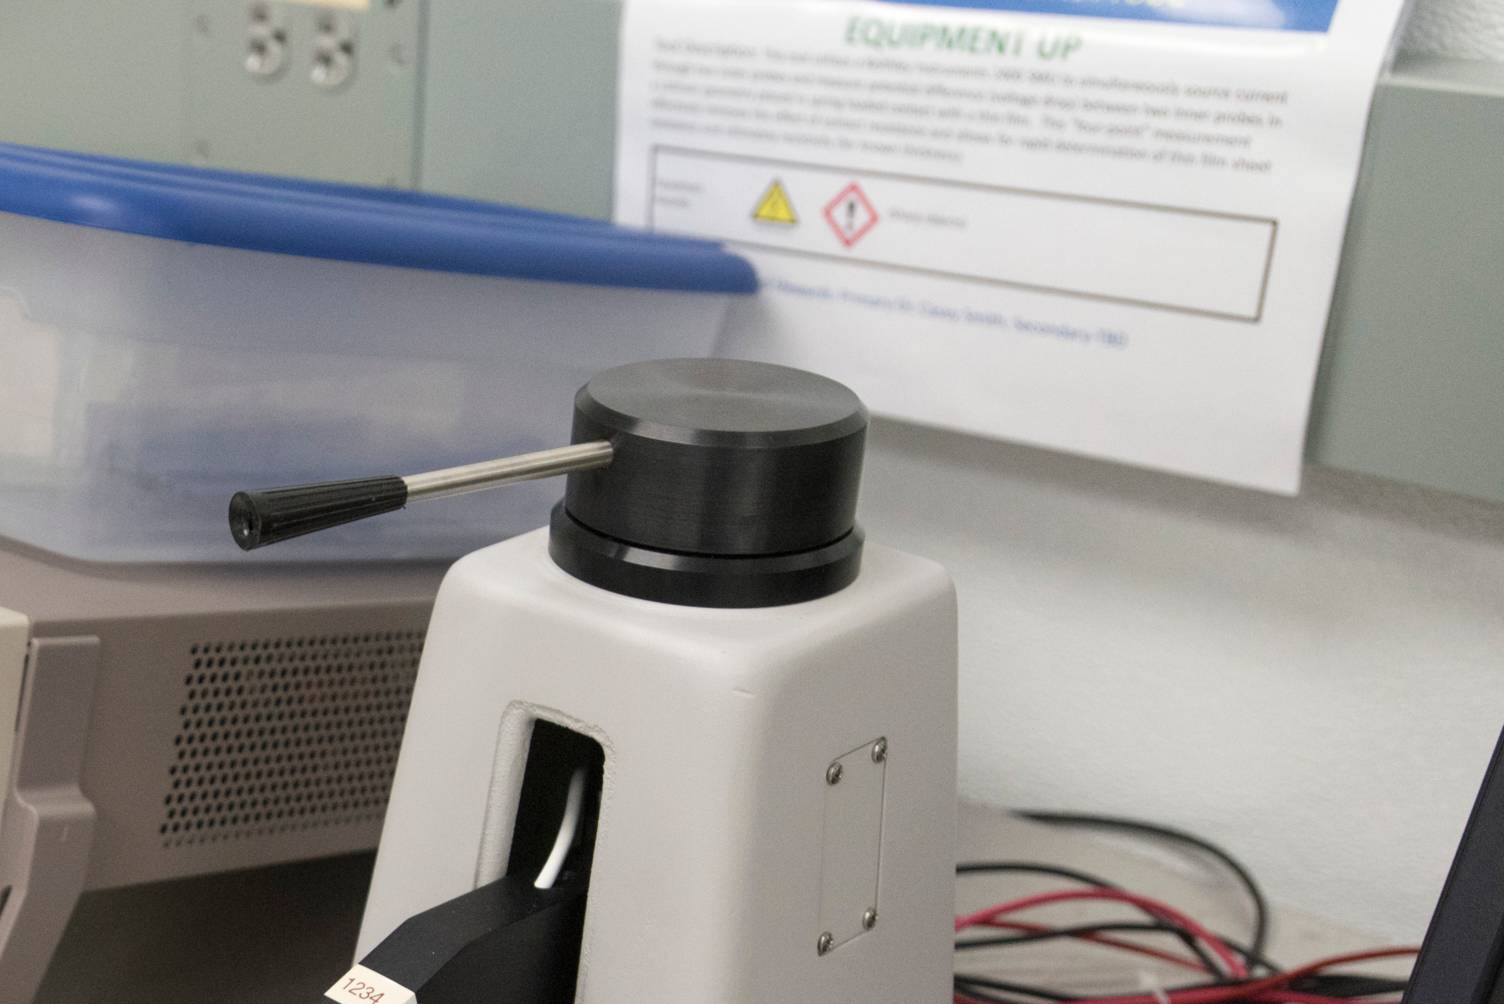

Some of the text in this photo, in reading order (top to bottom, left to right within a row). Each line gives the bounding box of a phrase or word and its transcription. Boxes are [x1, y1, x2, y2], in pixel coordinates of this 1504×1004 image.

[844, 15, 1025, 57] EQUIPMENT
[1037, 31, 1083, 61] UP
[342, 977, 385, 1004] 1234
